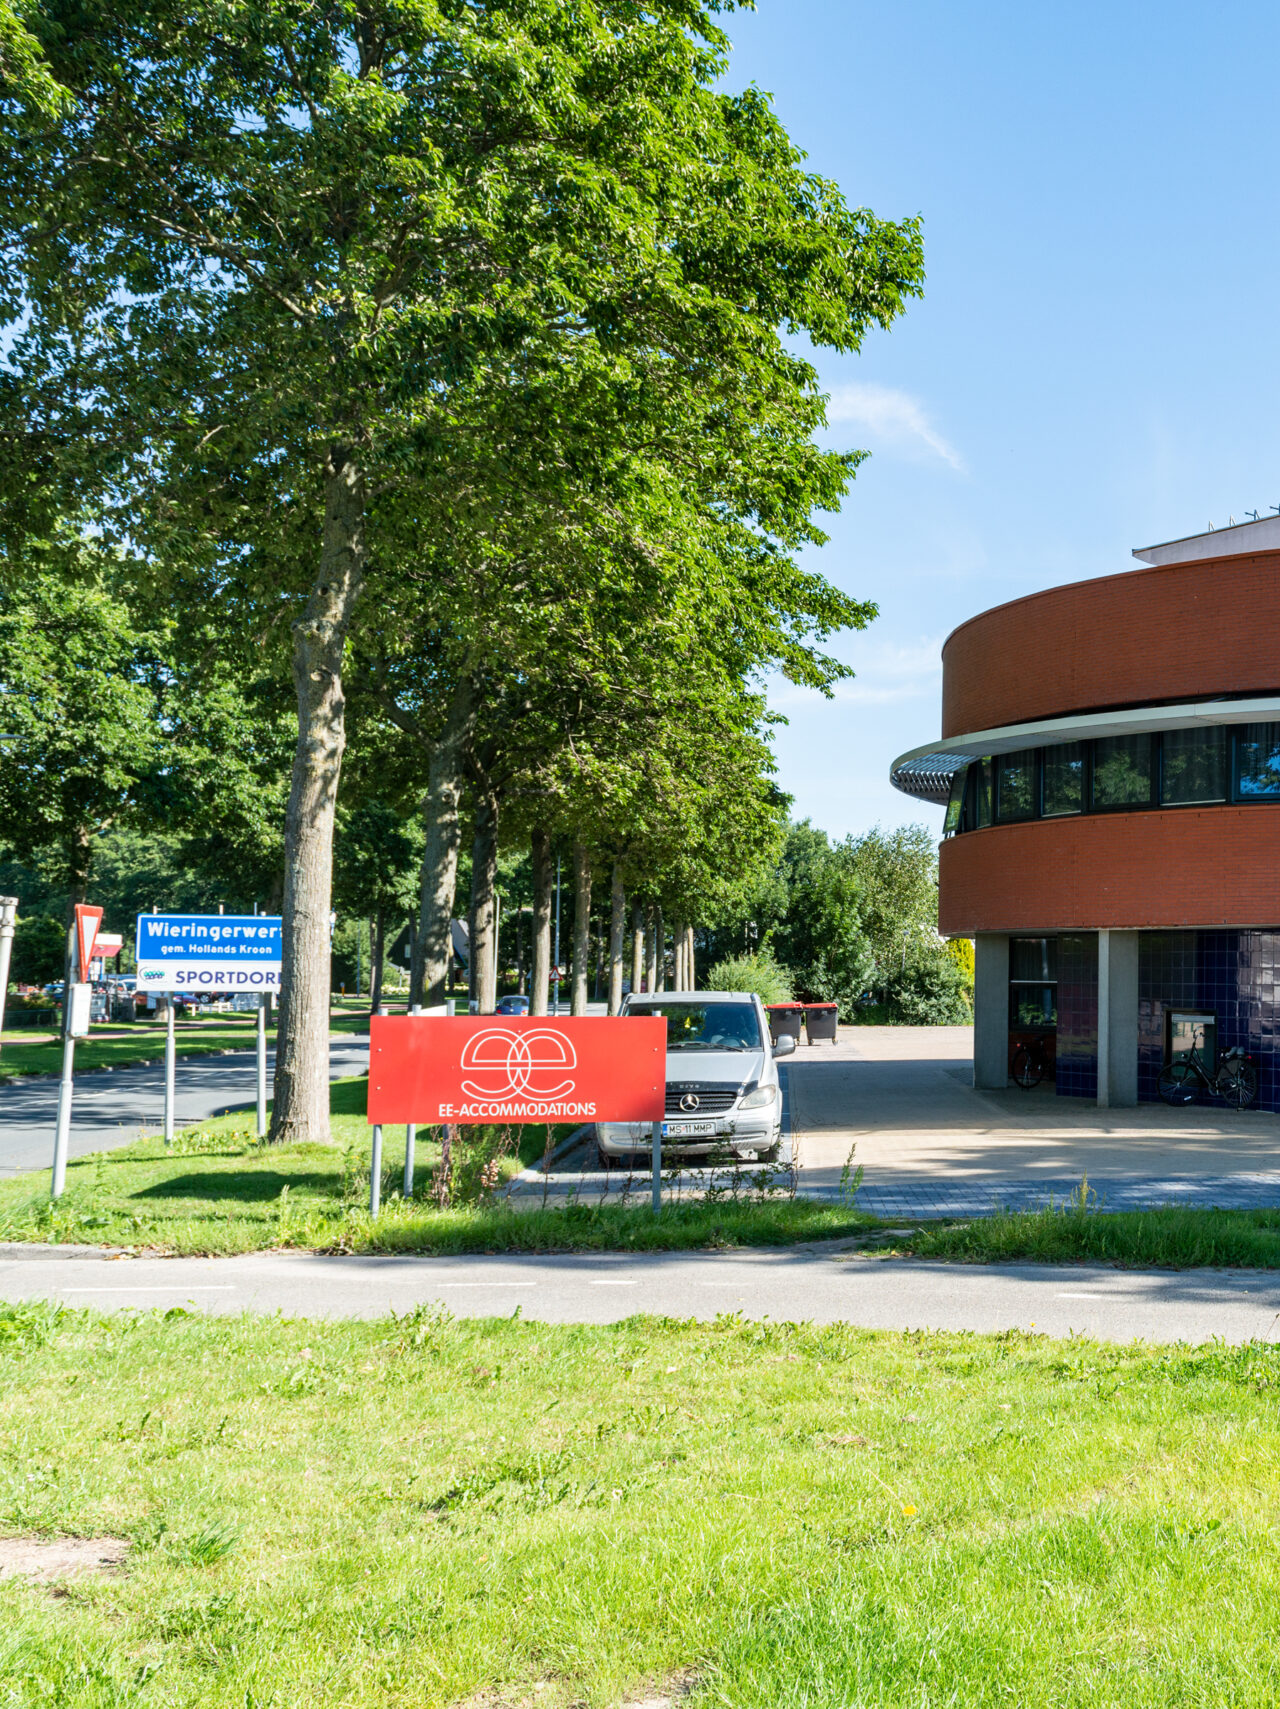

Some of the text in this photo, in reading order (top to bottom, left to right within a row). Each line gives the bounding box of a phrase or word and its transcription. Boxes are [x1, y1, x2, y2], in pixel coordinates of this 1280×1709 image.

[147, 921, 283, 941] Wieringerwer
[161, 944, 272, 955] gem. Hollands Kroon
[438, 1102, 597, 1117] EE-ACCOMMODATIONS
